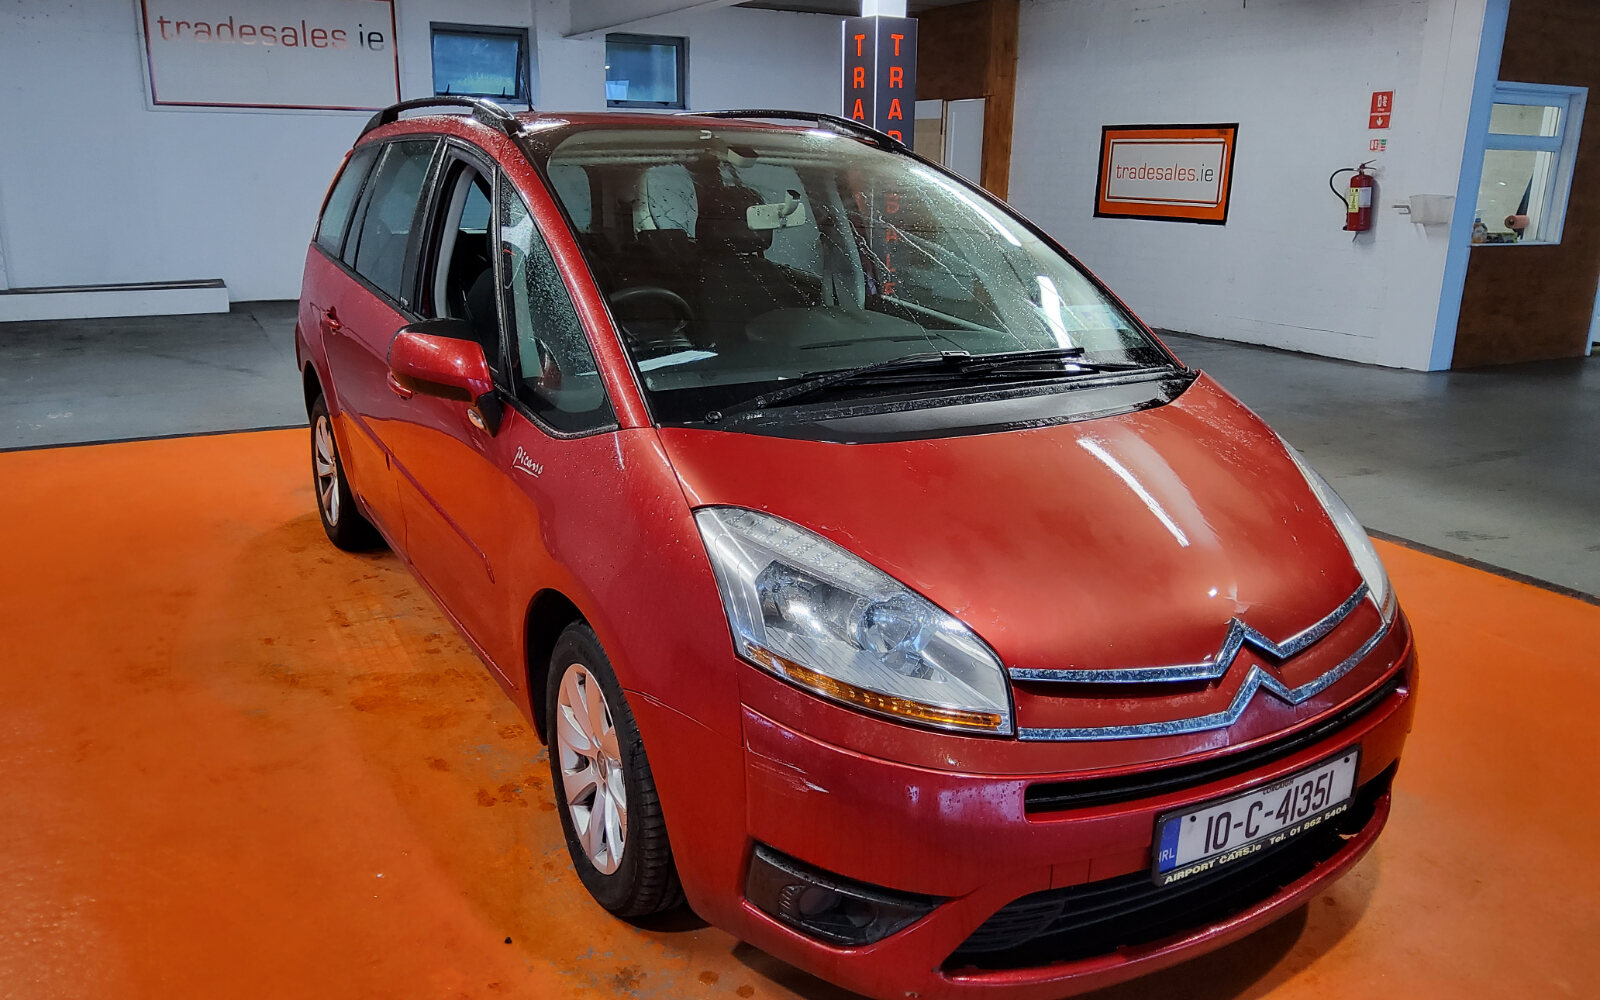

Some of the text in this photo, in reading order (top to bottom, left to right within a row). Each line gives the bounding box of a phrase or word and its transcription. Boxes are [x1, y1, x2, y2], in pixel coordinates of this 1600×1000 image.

[157, 15, 349, 50] tradesales
[1115, 162, 1214, 182] tradesales.ie
[511, 445, 544, 478] Picasso
[1203, 770, 1335, 854] 10-C-41351
[1158, 847, 1176, 864] IRL
[1164, 858, 1218, 885] AIRPORT
[1269, 832, 1287, 846] Tel.
[1289, 825, 1301, 837] 01
[1303, 815, 1322, 831] 862
[1324, 803, 1348, 821] 5404
